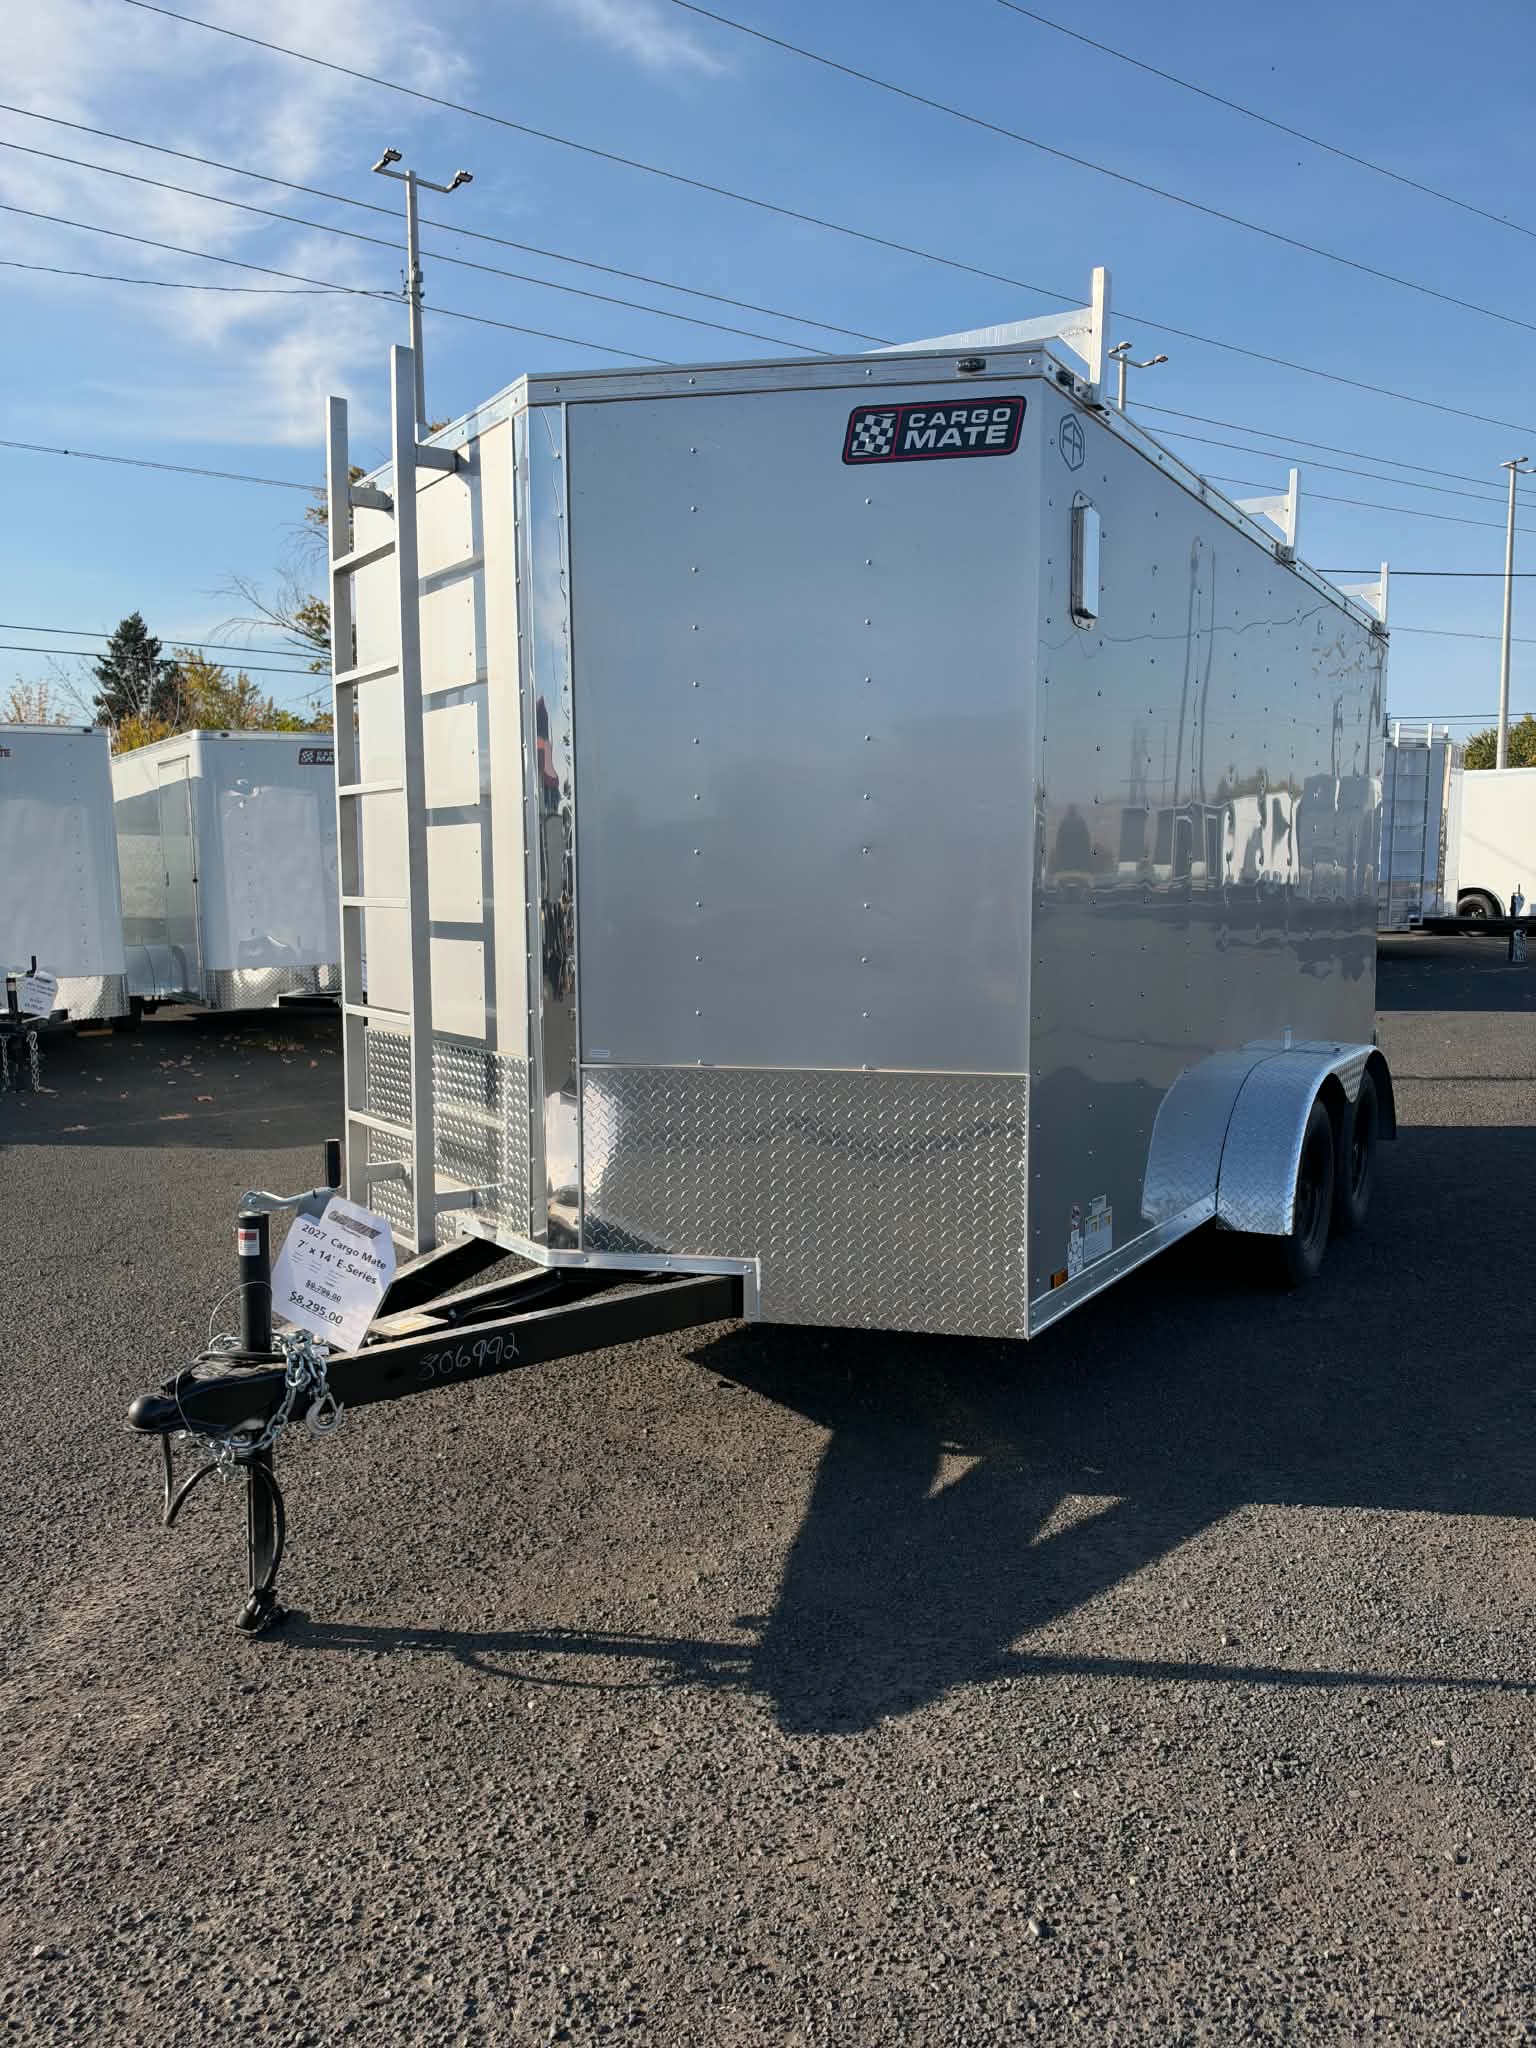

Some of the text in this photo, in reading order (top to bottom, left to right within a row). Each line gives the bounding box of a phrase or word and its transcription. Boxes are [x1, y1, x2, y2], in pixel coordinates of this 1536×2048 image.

[908, 407, 1011, 428] CARGO
[904, 424, 1009, 450] MATE
[302, 1224, 327, 1240] 2027
[331, 1238, 359, 1257] Cargo
[361, 1252, 387, 1270] Mate
[309, 1247, 316, 1255] x
[336, 1259, 377, 1285] E-Series
[289, 1290, 344, 1325] $8,295.00
